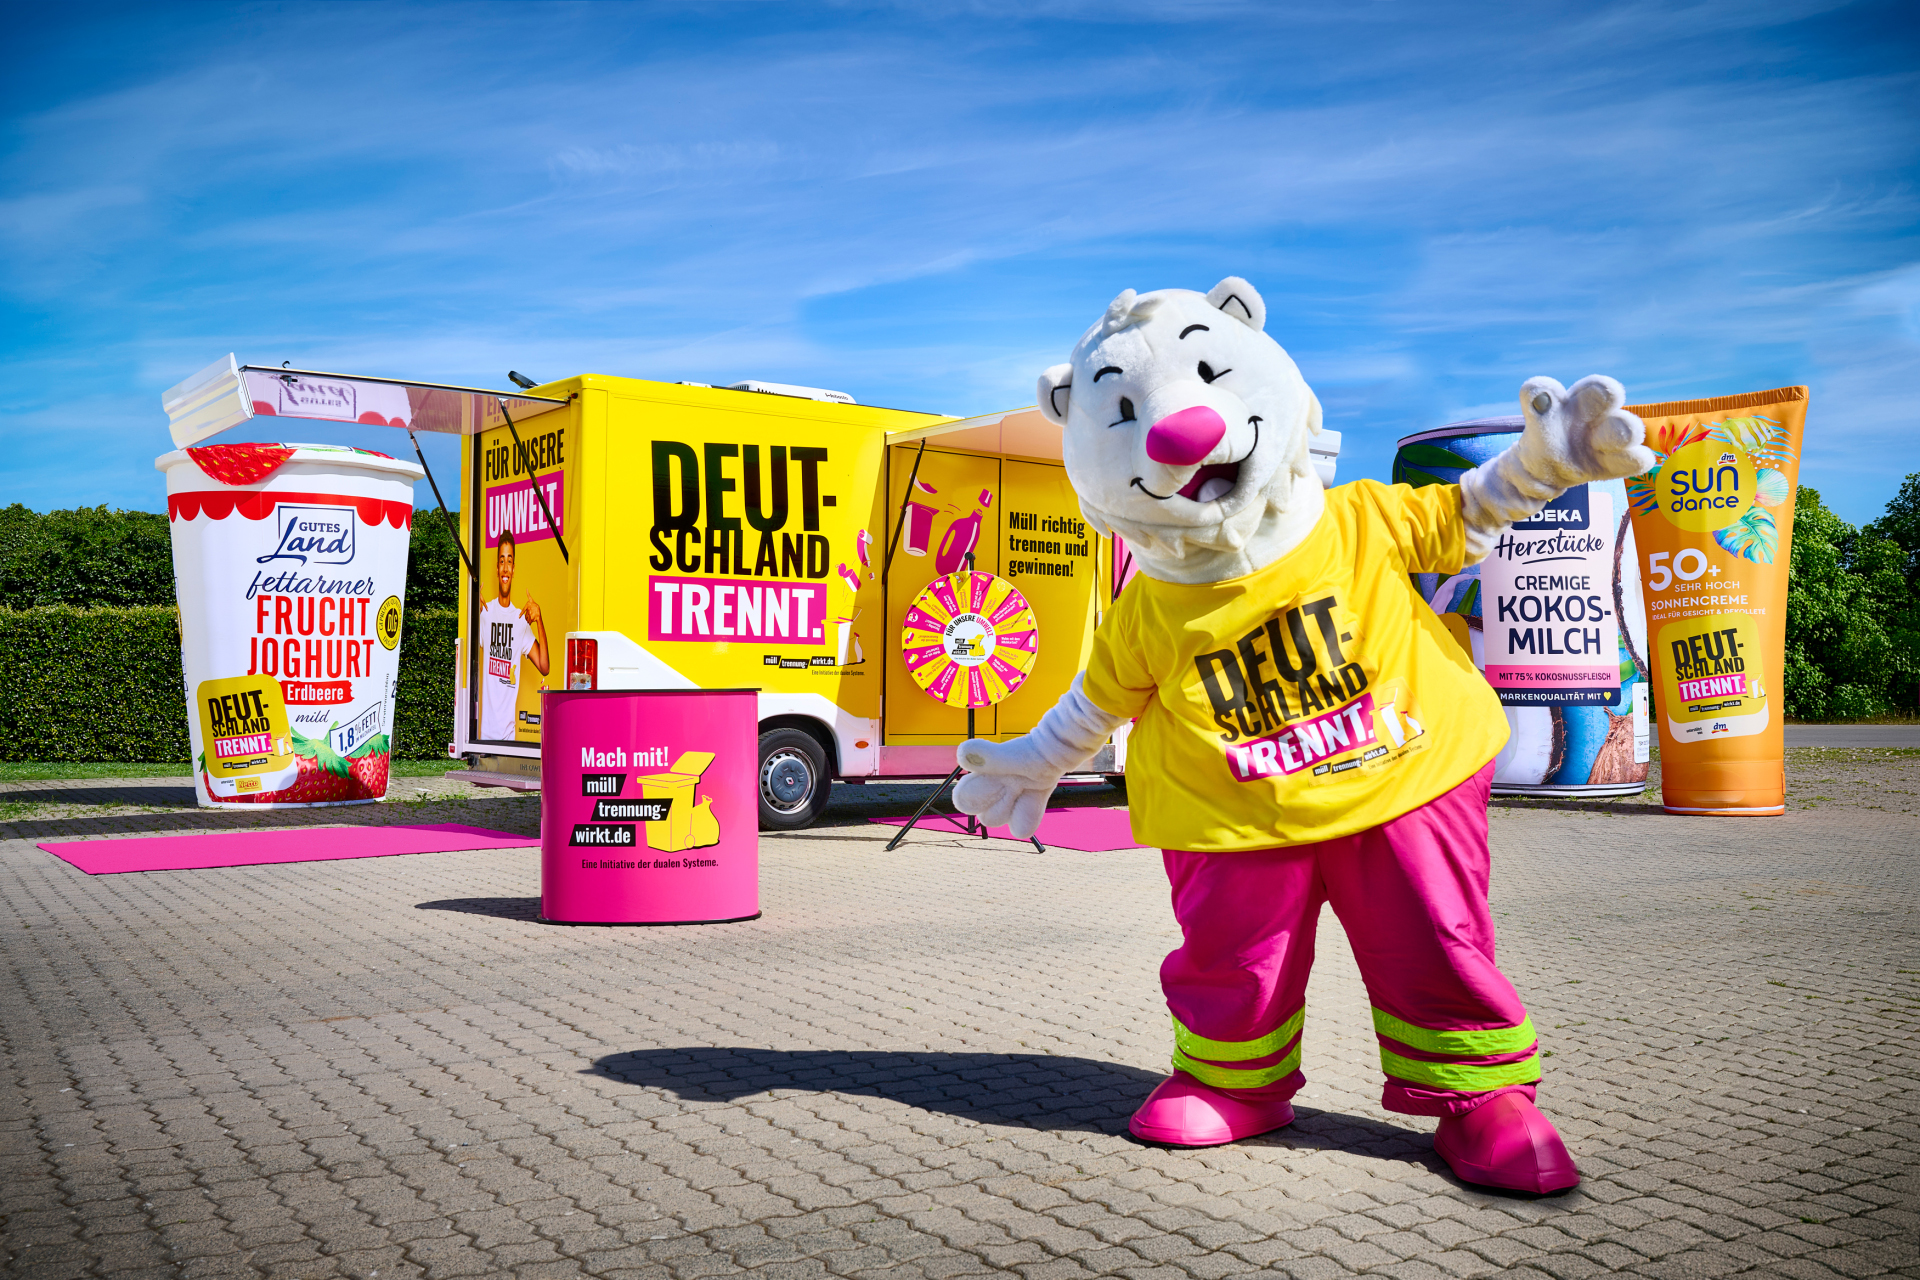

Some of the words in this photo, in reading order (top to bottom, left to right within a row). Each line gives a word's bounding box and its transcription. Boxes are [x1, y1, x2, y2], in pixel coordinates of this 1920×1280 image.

[486, 439, 509, 482] FÜR
[513, 428, 565, 476] UNSERE
[651, 440, 837, 532] DEUT-
[1522, 509, 1583, 522] DEKA
[1671, 496, 1739, 513] dance
[299, 522, 340, 532] GUTES
[1009, 511, 1037, 531] Müll
[1042, 516, 1085, 539] richtig
[256, 516, 351, 567] Land
[649, 524, 830, 579] SCHLAND
[1009, 535, 1061, 555] trennen
[1065, 540, 1088, 557] und
[1494, 529, 1604, 561] Herzstücke
[1009, 558, 1074, 577] gewinnen!
[1648, 548, 1721, 592] 50+
[246, 570, 375, 600] fettarmer
[1514, 575, 1591, 591] CREMIGE
[1675, 583, 1702, 592] SEHR
[1706, 580, 1740, 590] HOCH
[654, 582, 822, 638] TRENNT.
[1498, 595, 1612, 622] KOKOS-
[1651, 595, 1748, 611] SONNENCREME
[1668, 610, 1680, 618] FÜR
[256, 594, 370, 636] FRUCHT
[946, 624, 956, 636] FÜR
[953, 615, 976, 626] UNSERE
[975, 617, 994, 638] UMWELT
[491, 622, 514, 647] DEUT-
[1509, 628, 1601, 655] MILCH
[247, 637, 374, 678] JOGHURT
[490, 645, 512, 660] SCHLAND
[1194, 595, 1353, 712] DEUT-
[1671, 627, 1744, 668] DEUT-
[766, 656, 778, 664] müll
[1675, 656, 1745, 681] SCHLAND
[1499, 672, 1514, 680] MIT
[1535, 672, 1611, 680] KOKOSNUSSFLEISCH
[287, 684, 344, 701] Erdbeere
[1500, 692, 1584, 701] MARKENQUALITÄT
[1680, 676, 1747, 700] TRENNT.
[207, 689, 269, 725] DEUT-
[1214, 662, 1368, 742] SCHLAND
[211, 717, 271, 738] SCHLAND
[295, 709, 331, 724] mild
[1714, 722, 1726, 730] dm
[339, 728, 355, 753] 1,8
[361, 711, 377, 731] FETT
[1229, 701, 1375, 778] TRENNT.
[215, 735, 272, 757] TRENNT.
[581, 747, 627, 768] Mach
[633, 746, 669, 767] mit!
[1314, 764, 1328, 775] müll
[1364, 747, 1387, 761] wirkt.de
[586, 777, 617, 794] müll
[598, 803, 667, 820] trennung-
[575, 827, 631, 844] wirkt.de
[582, 859, 597, 868] Eine
[600, 859, 635, 868] Initiative
[638, 859, 650, 868] der
[654, 859, 680, 868] dualen
[683, 858, 718, 869] Systeme.
